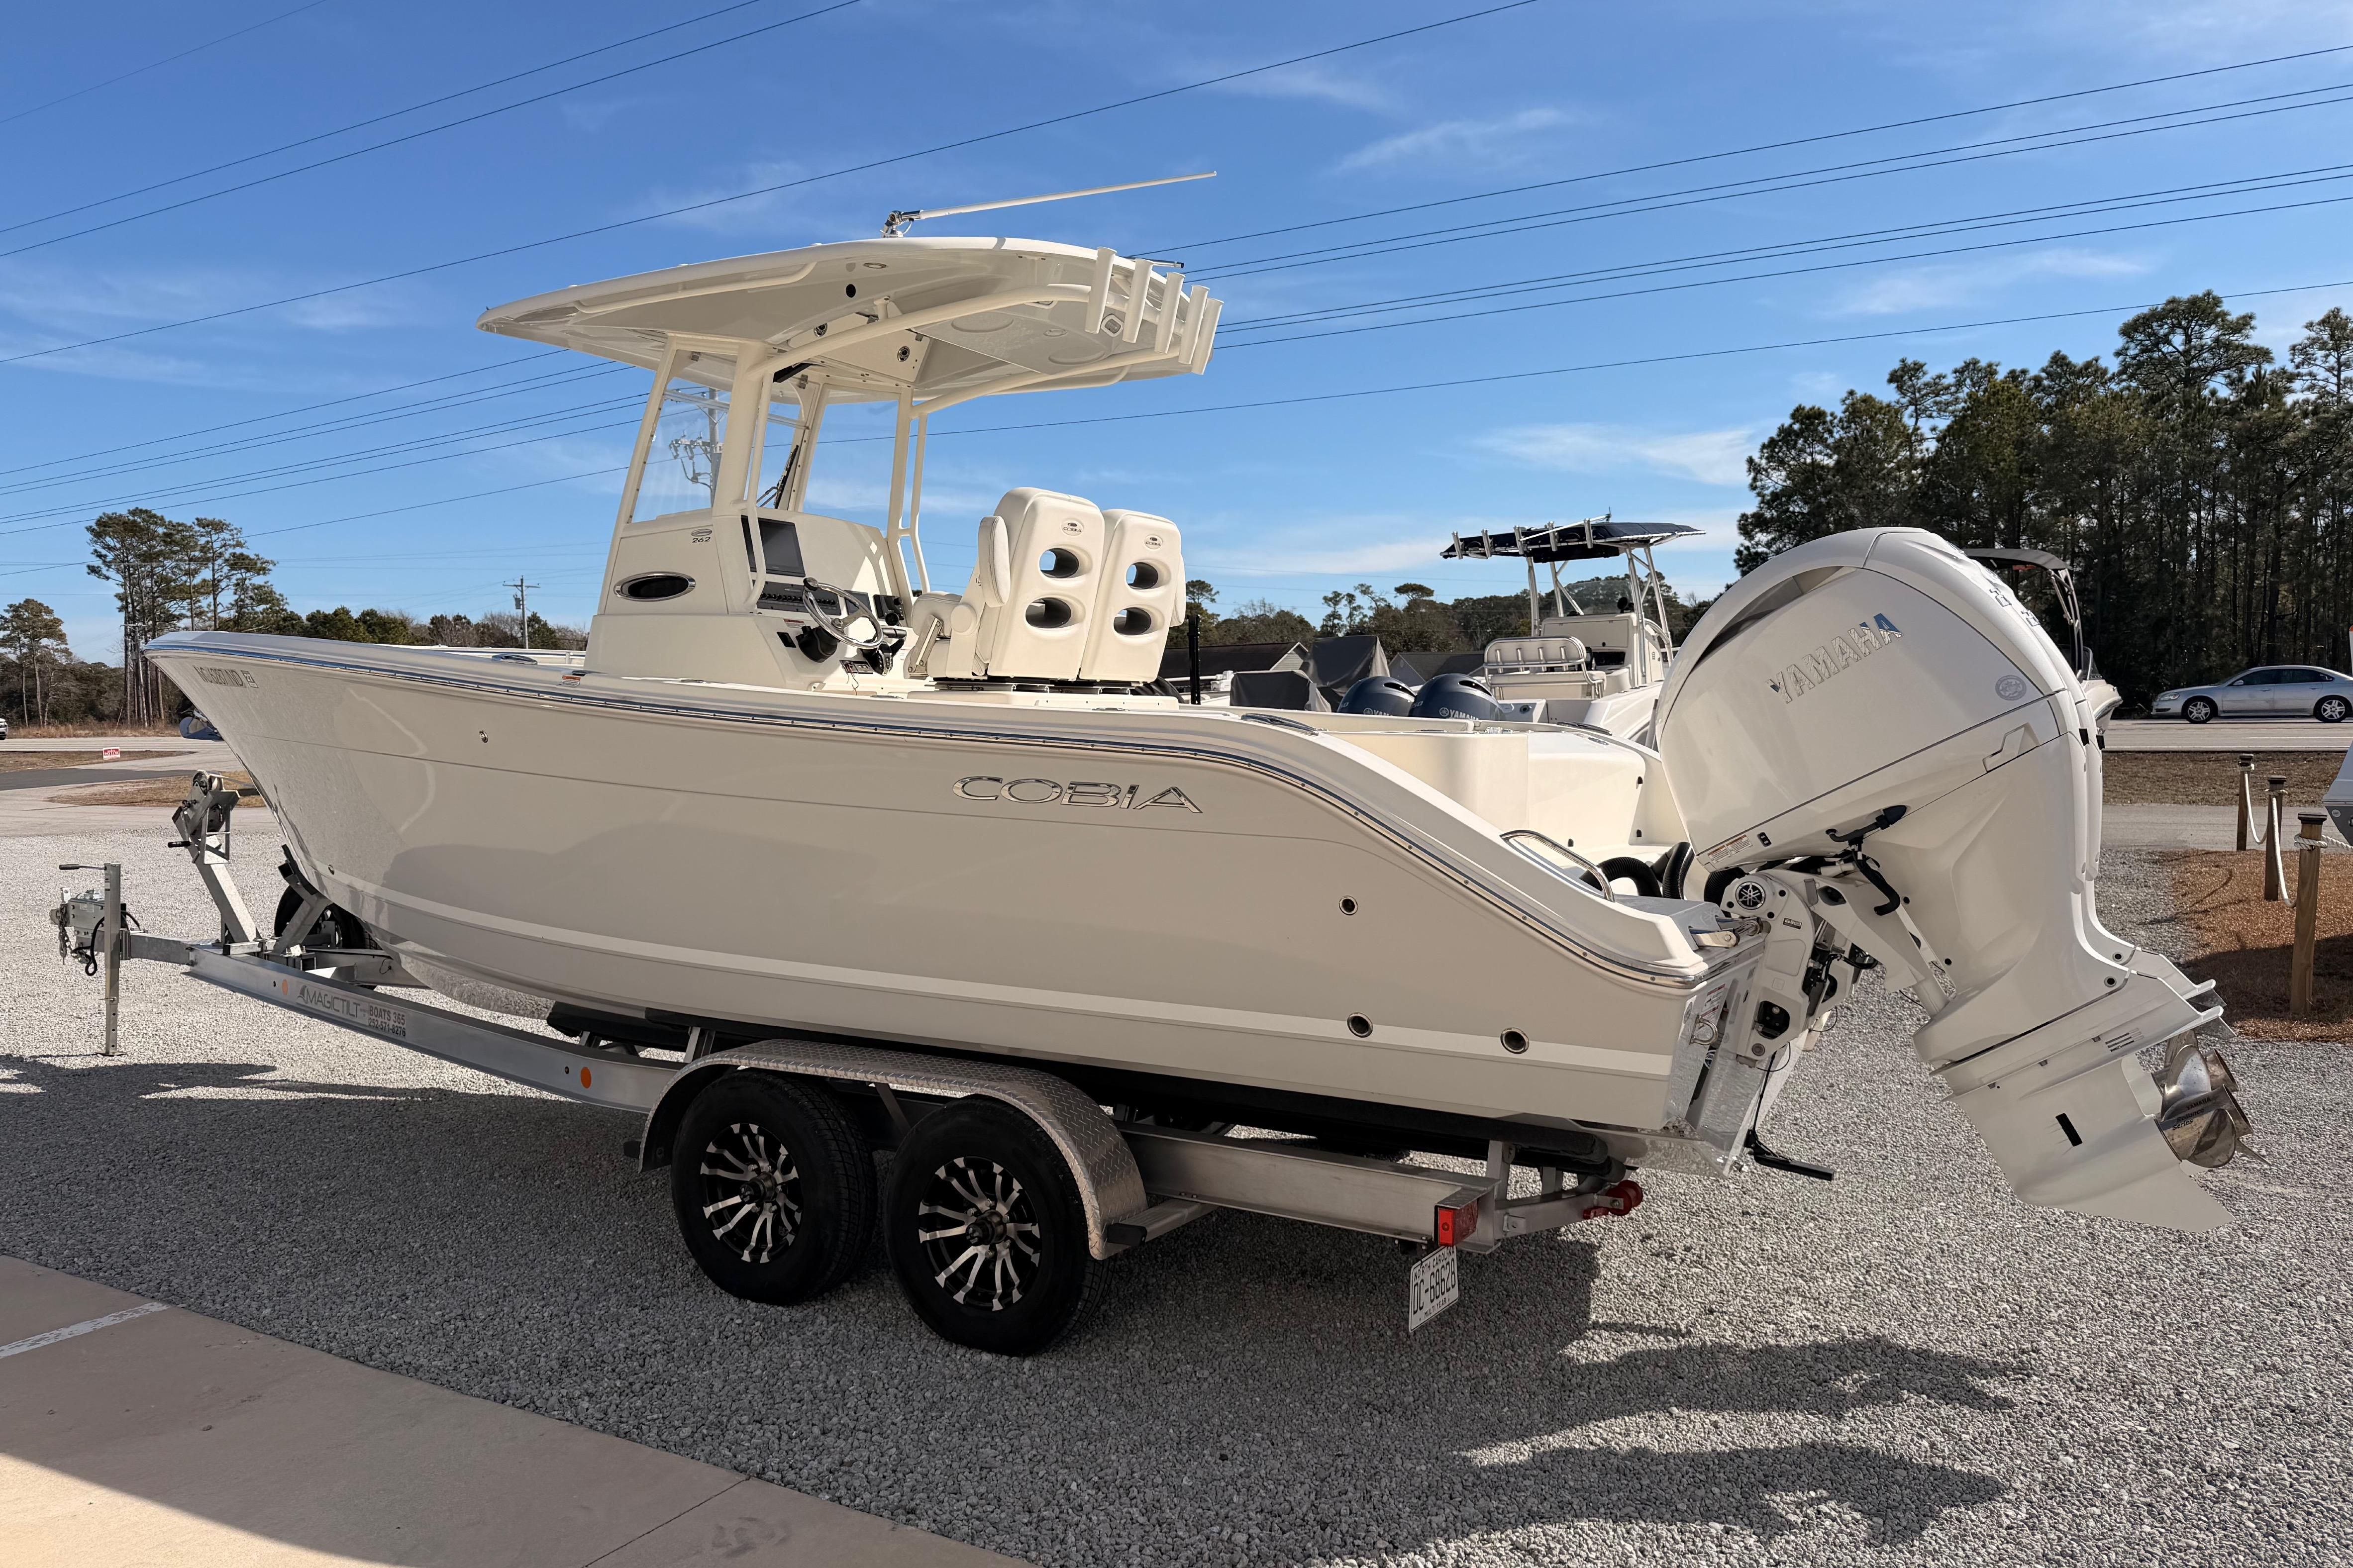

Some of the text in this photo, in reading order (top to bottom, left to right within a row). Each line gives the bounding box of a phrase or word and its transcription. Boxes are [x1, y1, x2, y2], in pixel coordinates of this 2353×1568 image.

[1765, 613, 1903, 704] YAMAHA
[951, 775, 1204, 814] COBIA
[306, 987, 361, 1018] MAGICTILT
[370, 1005, 391, 1022] BOATS
[393, 1011, 406, 1026] 365
[369, 1017, 407, 1037] 252-571-8276
[2186, 1096, 2212, 1110] YAMAHA
[1414, 1246, 1455, 1281] NORTH CAROLINA
[1413, 1258, 1456, 1315] DC-68628
[1436, 1297, 1447, 1309] YEAR
